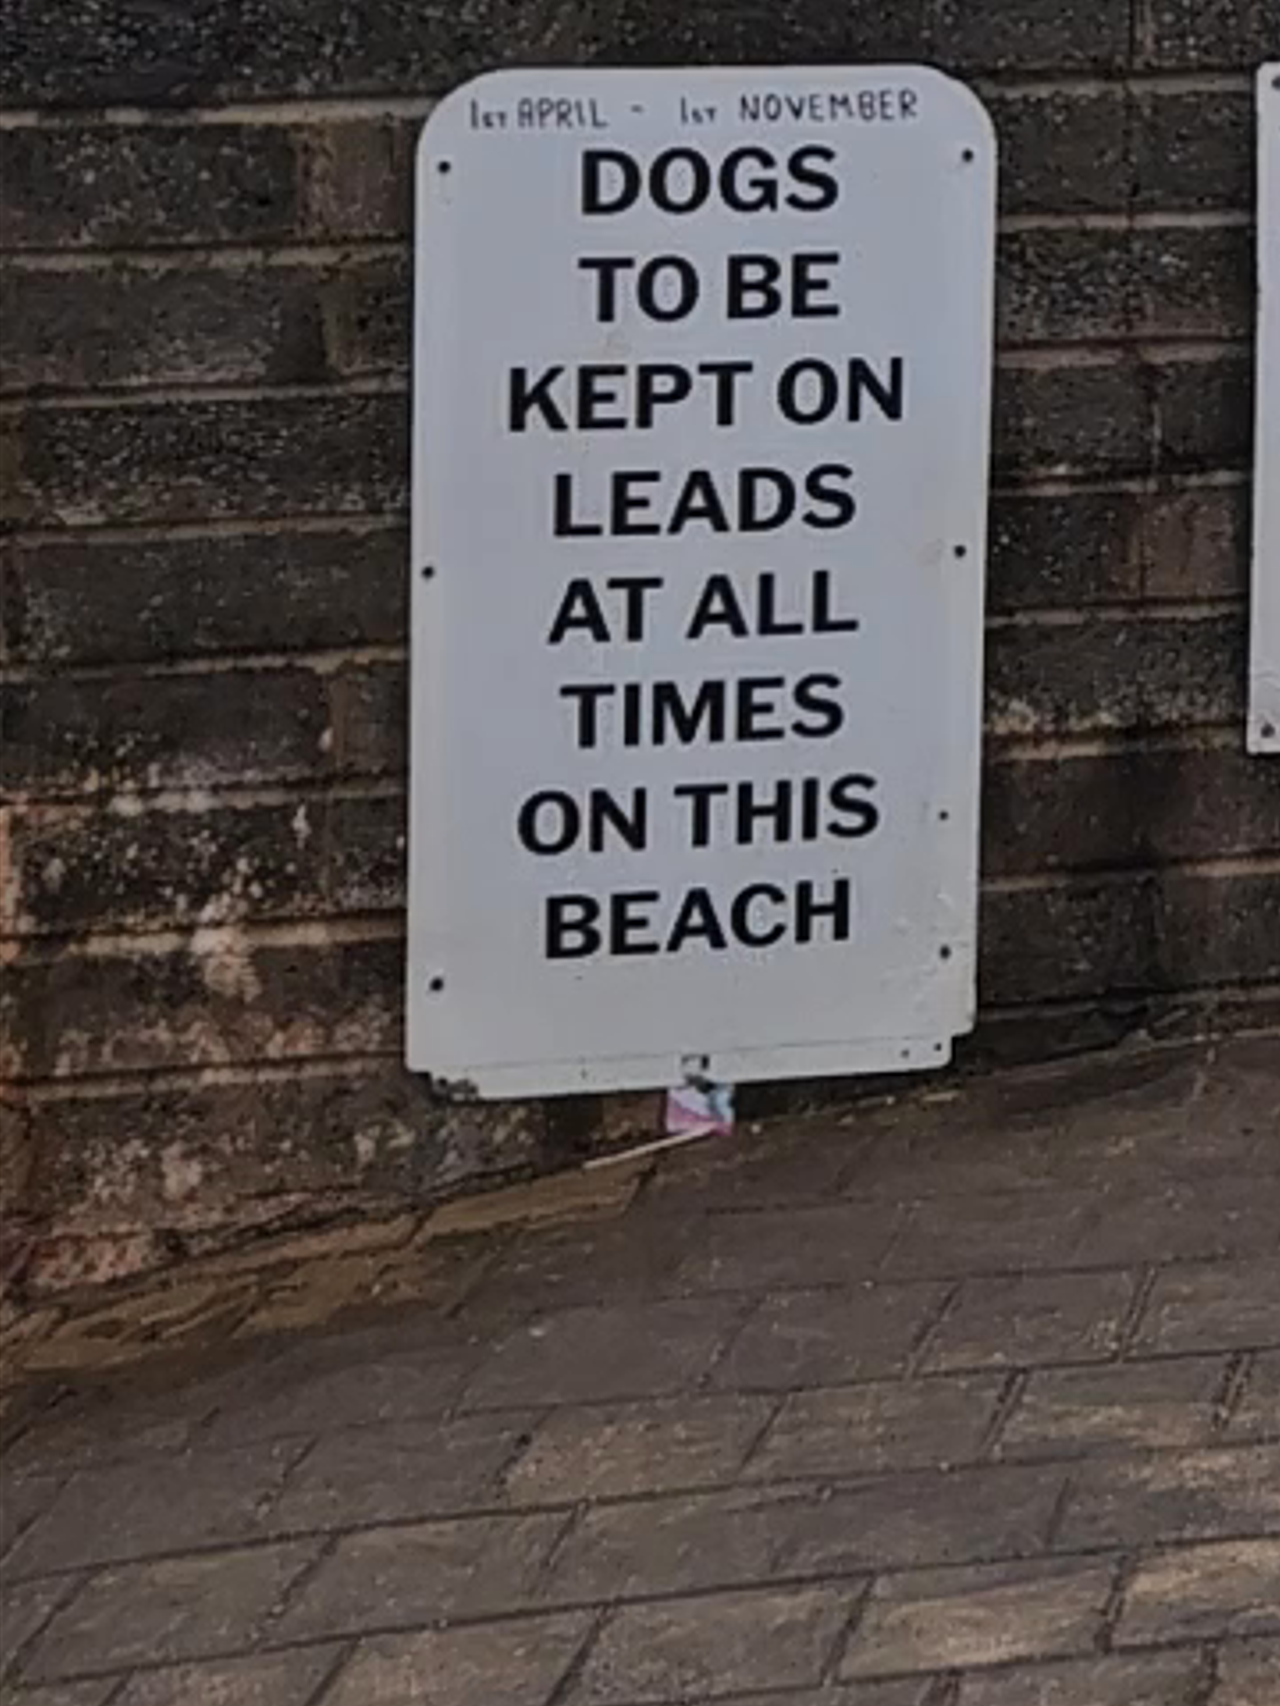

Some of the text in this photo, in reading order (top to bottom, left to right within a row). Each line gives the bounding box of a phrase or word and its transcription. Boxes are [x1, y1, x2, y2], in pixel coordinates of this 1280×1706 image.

[517, 97, 608, 129] APRIL
[739, 88, 917, 122] NOVEMBER
[581, 144, 839, 216] DOGS
[577, 252, 840, 323] TO BE
[509, 357, 903, 432] KEPT ON
[553, 464, 856, 538] LEADS
[547, 570, 859, 645] AT ALL
[559, 673, 844, 749] TIMES
[517, 773, 879, 856] ON THIS
[545, 877, 850, 959] BEACH
